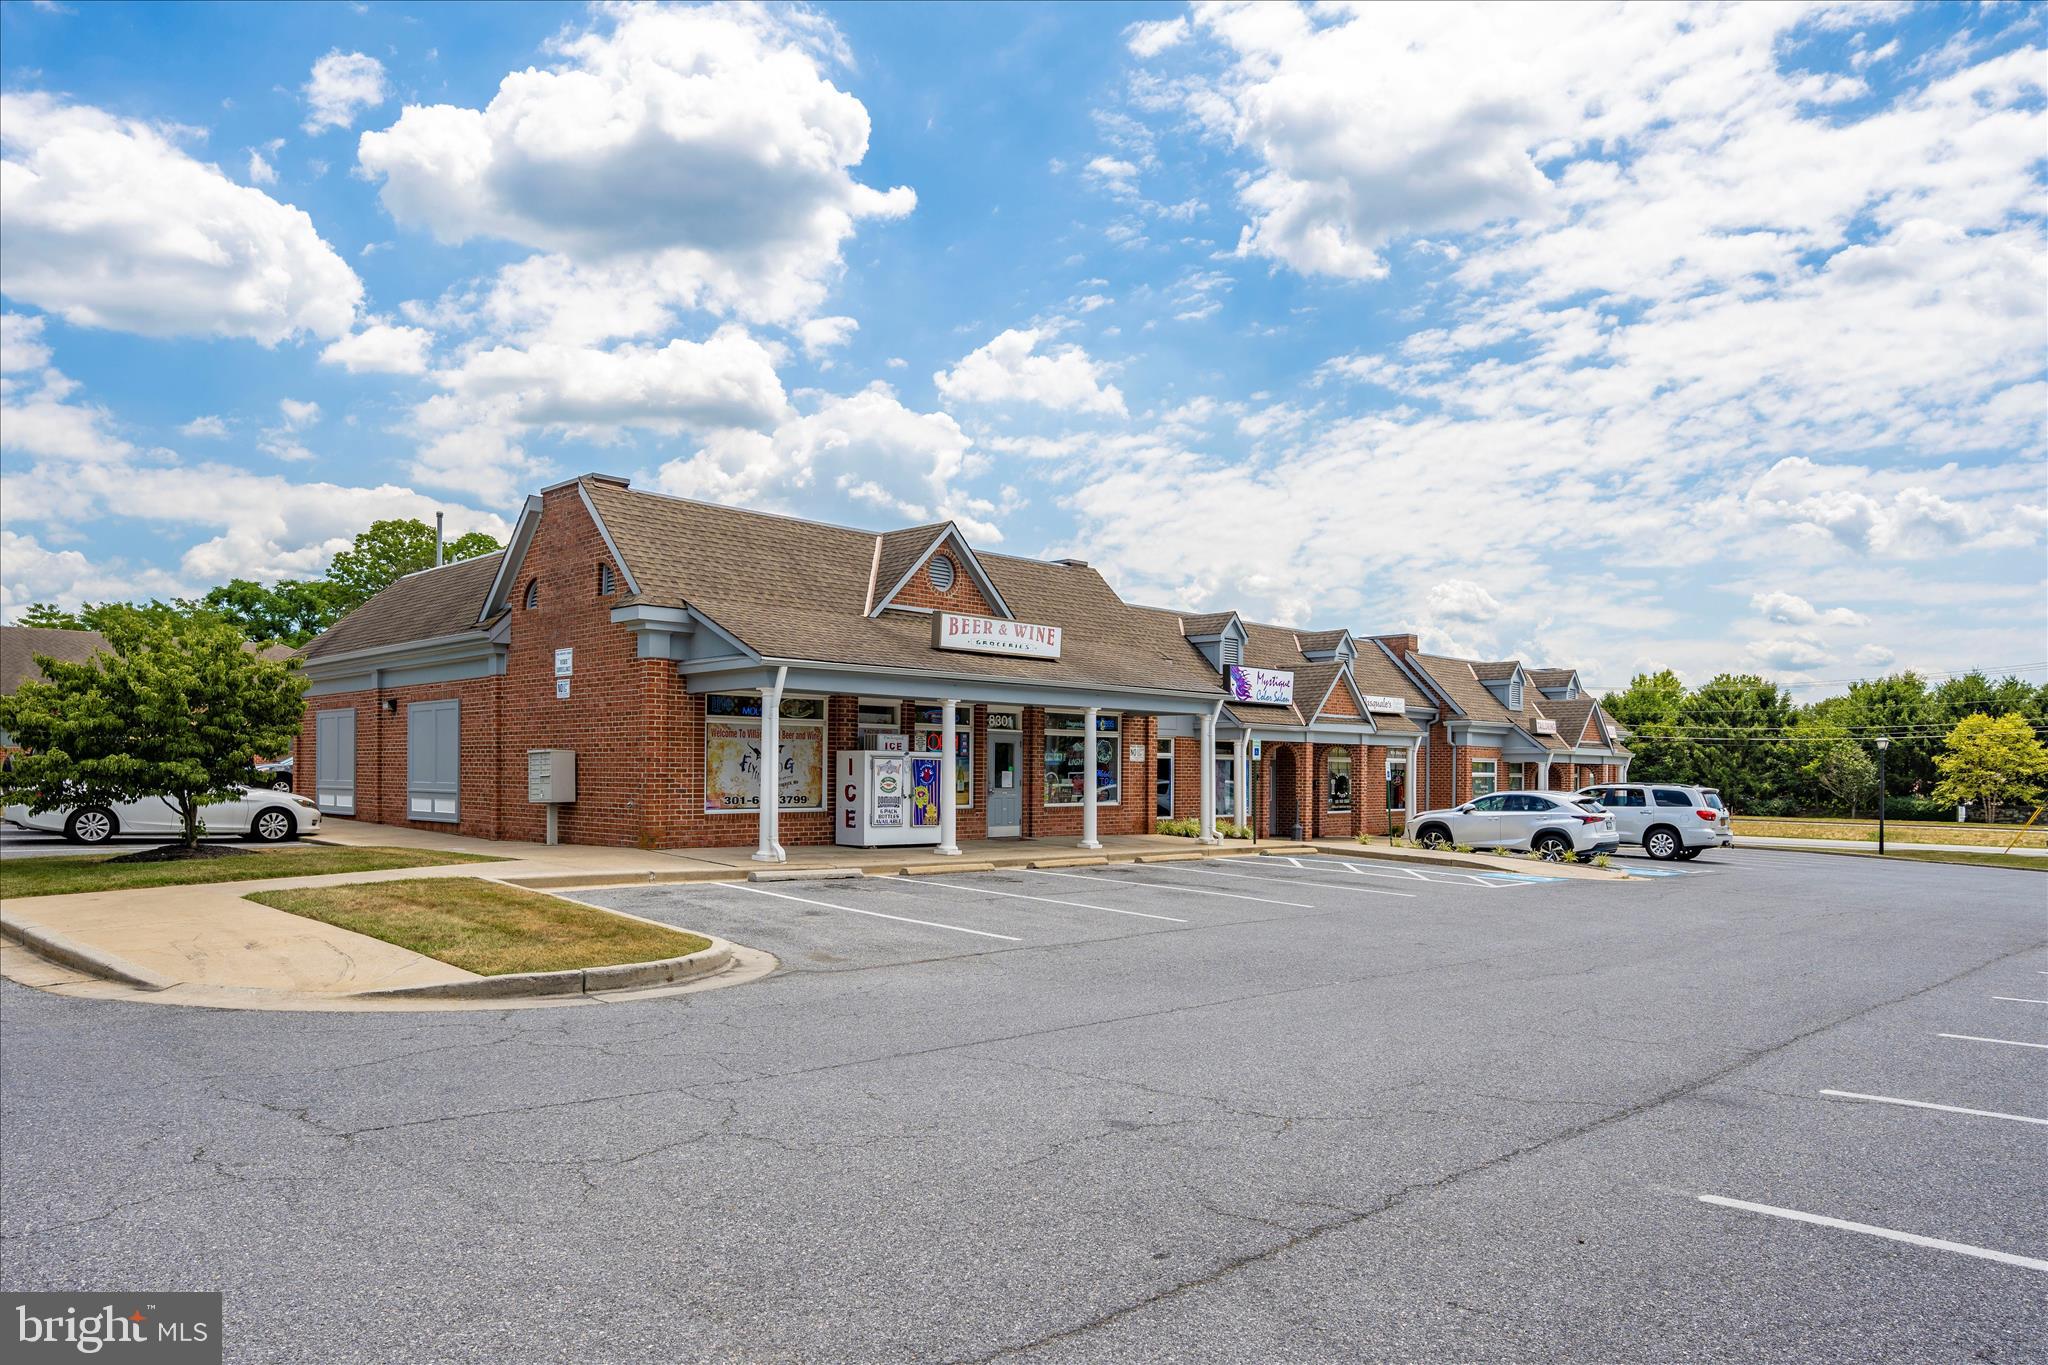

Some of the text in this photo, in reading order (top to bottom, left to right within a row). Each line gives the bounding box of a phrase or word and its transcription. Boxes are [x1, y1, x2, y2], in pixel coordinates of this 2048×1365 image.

[949, 616, 1055, 646] BEER & WINE
[976, 640, 1030, 650] GROCERIES
[1256, 671, 1291, 692] Mystique
[1256, 689, 1290, 703] Color Salon
[988, 714, 1014, 729] 8301
[710, 728, 738, 738] Welcome
[738, 729, 747, 738] To
[782, 729, 795, 740] Beer
[796, 731, 806, 740] and
[885, 742, 903, 751] ICE
[844, 758, 857, 829] ICE
